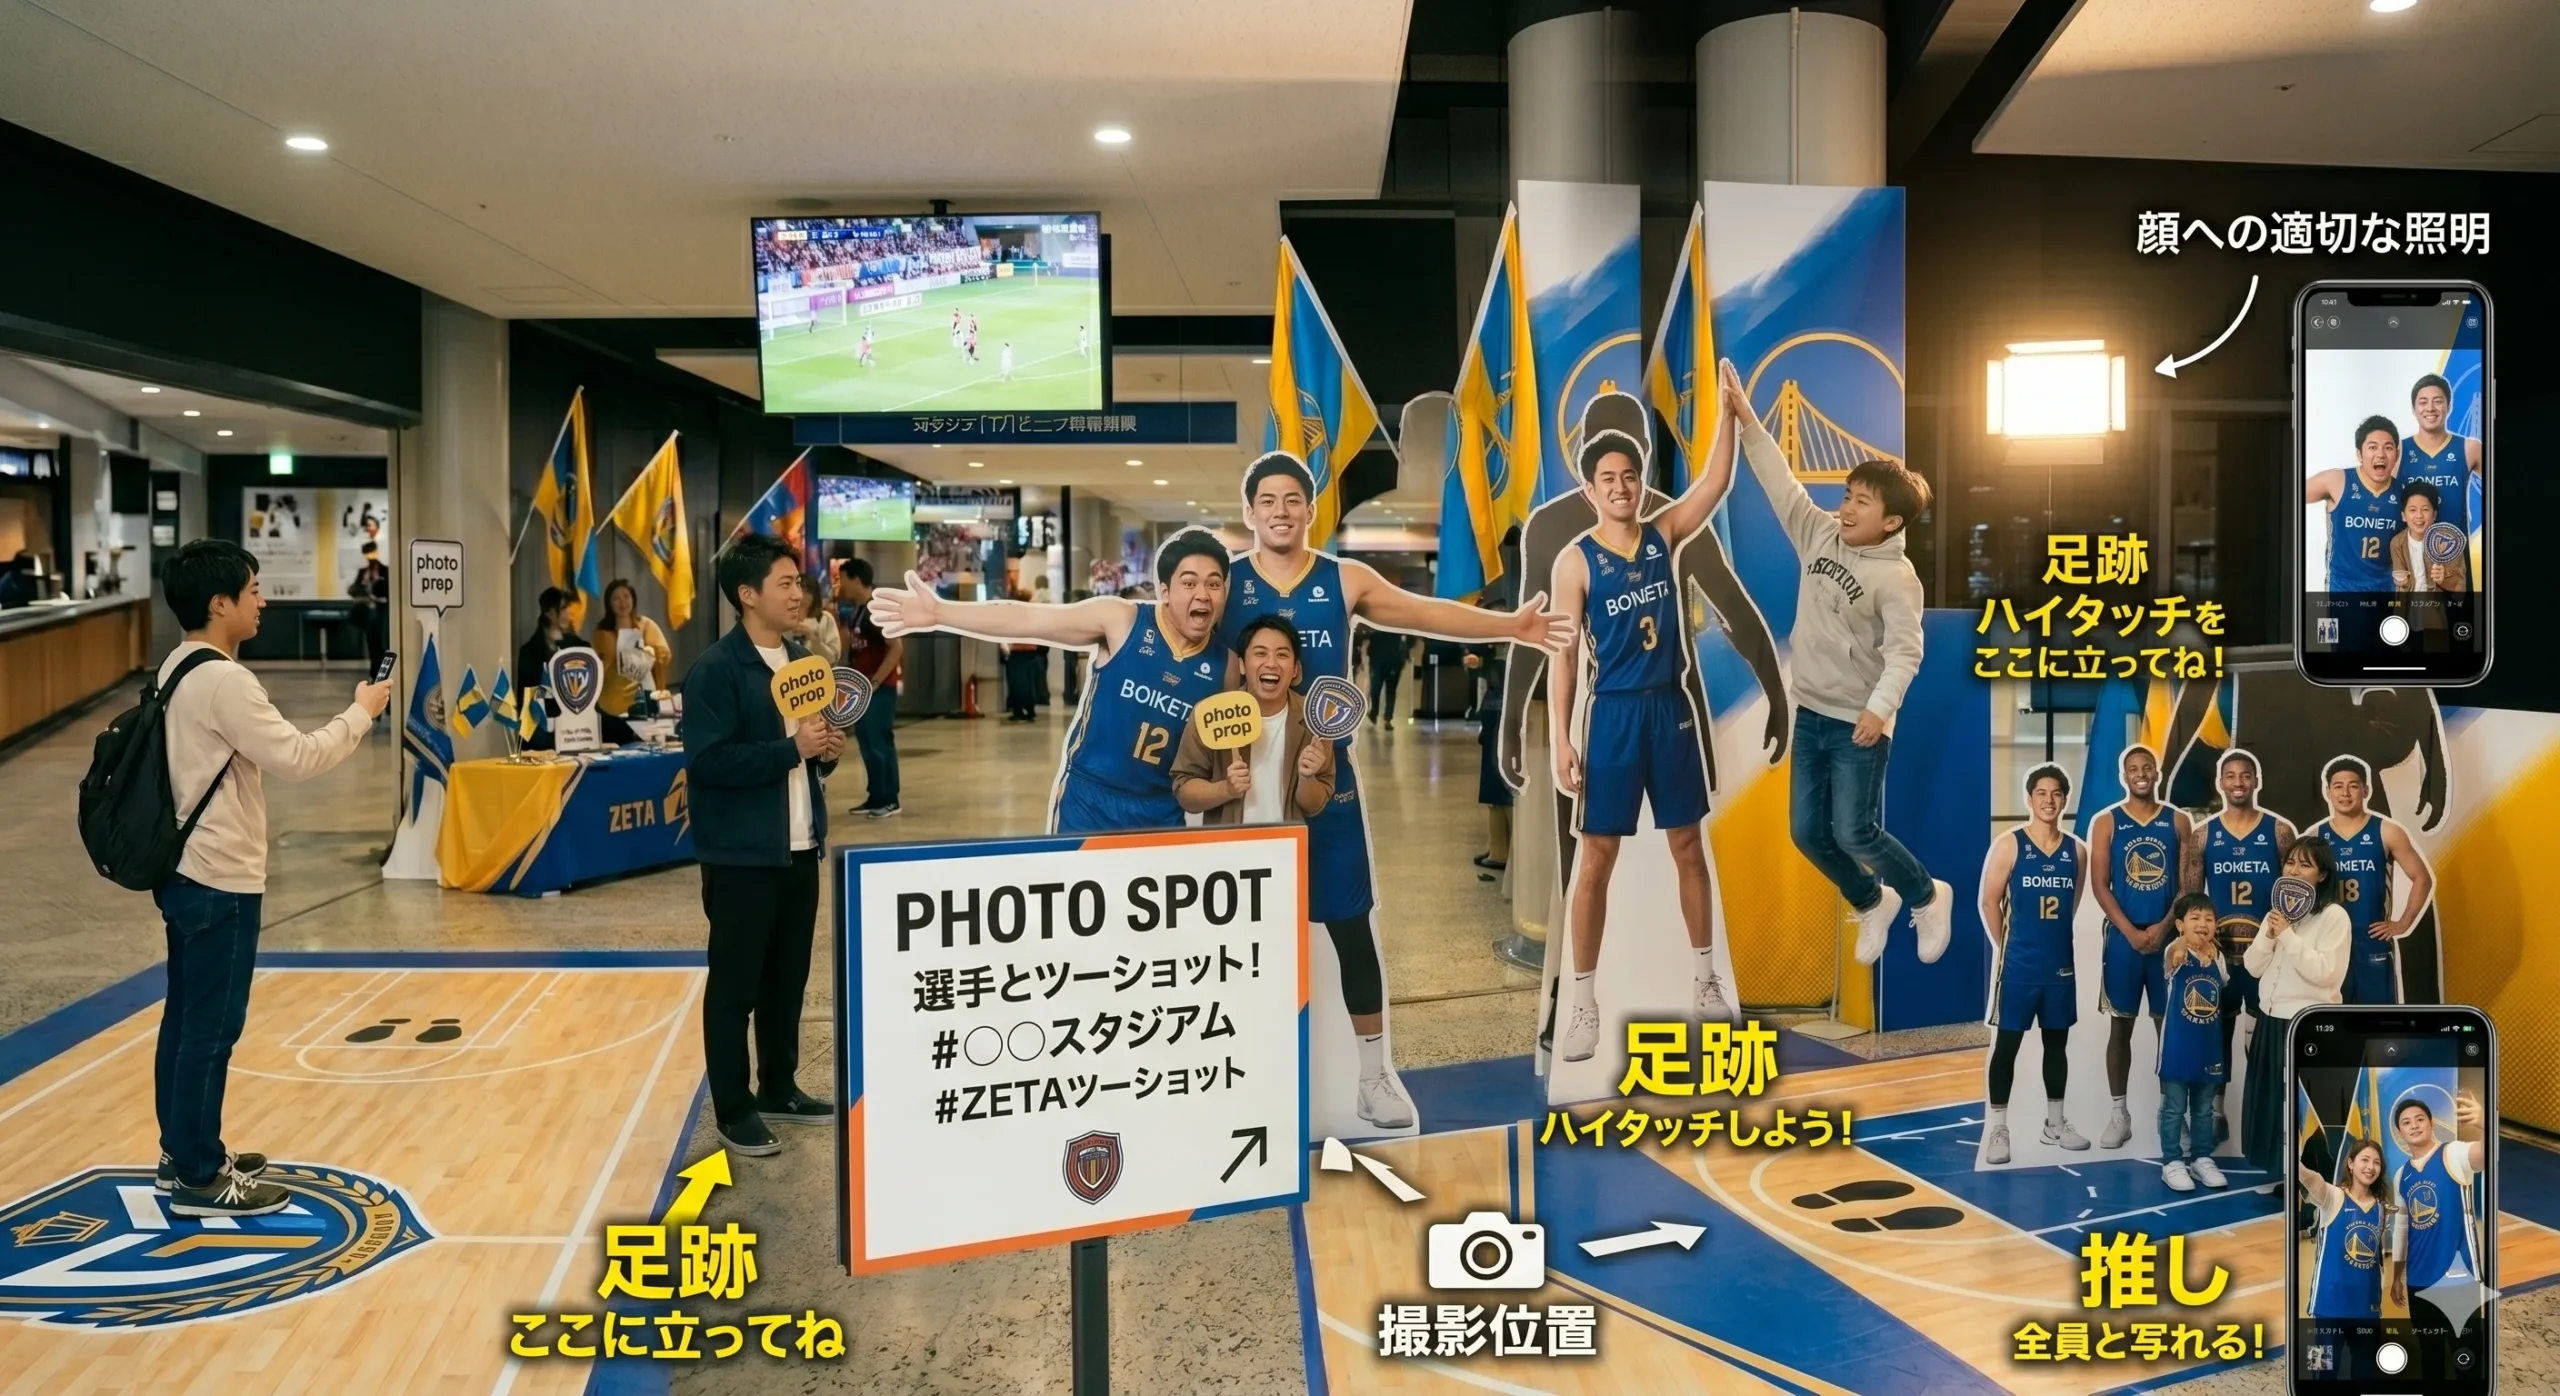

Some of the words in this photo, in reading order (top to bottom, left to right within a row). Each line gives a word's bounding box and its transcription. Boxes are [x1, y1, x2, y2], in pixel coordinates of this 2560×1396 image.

[2361, 536, 2380, 559] 12
[417, 553, 458, 574] photo
[1639, 616, 1658, 651] 3
[779, 669, 825, 698] photo
[789, 686, 826, 711] prop
[1120, 678, 1194, 722] BOIKET
[1203, 704, 1252, 728] photo
[1132, 721, 1170, 765] 12
[1213, 721, 1252, 741] prop
[609, 800, 656, 833] ZETA
[2230, 880, 2253, 905] 12
[896, 880, 1106, 952] PHOTO
[1127, 868, 1272, 932] SPOT
[2040, 895, 2060, 920] 12
[913, 942, 1261, 1013] 選手とツーショット!
[934, 1056, 1246, 1125] #ZETAツーショット
